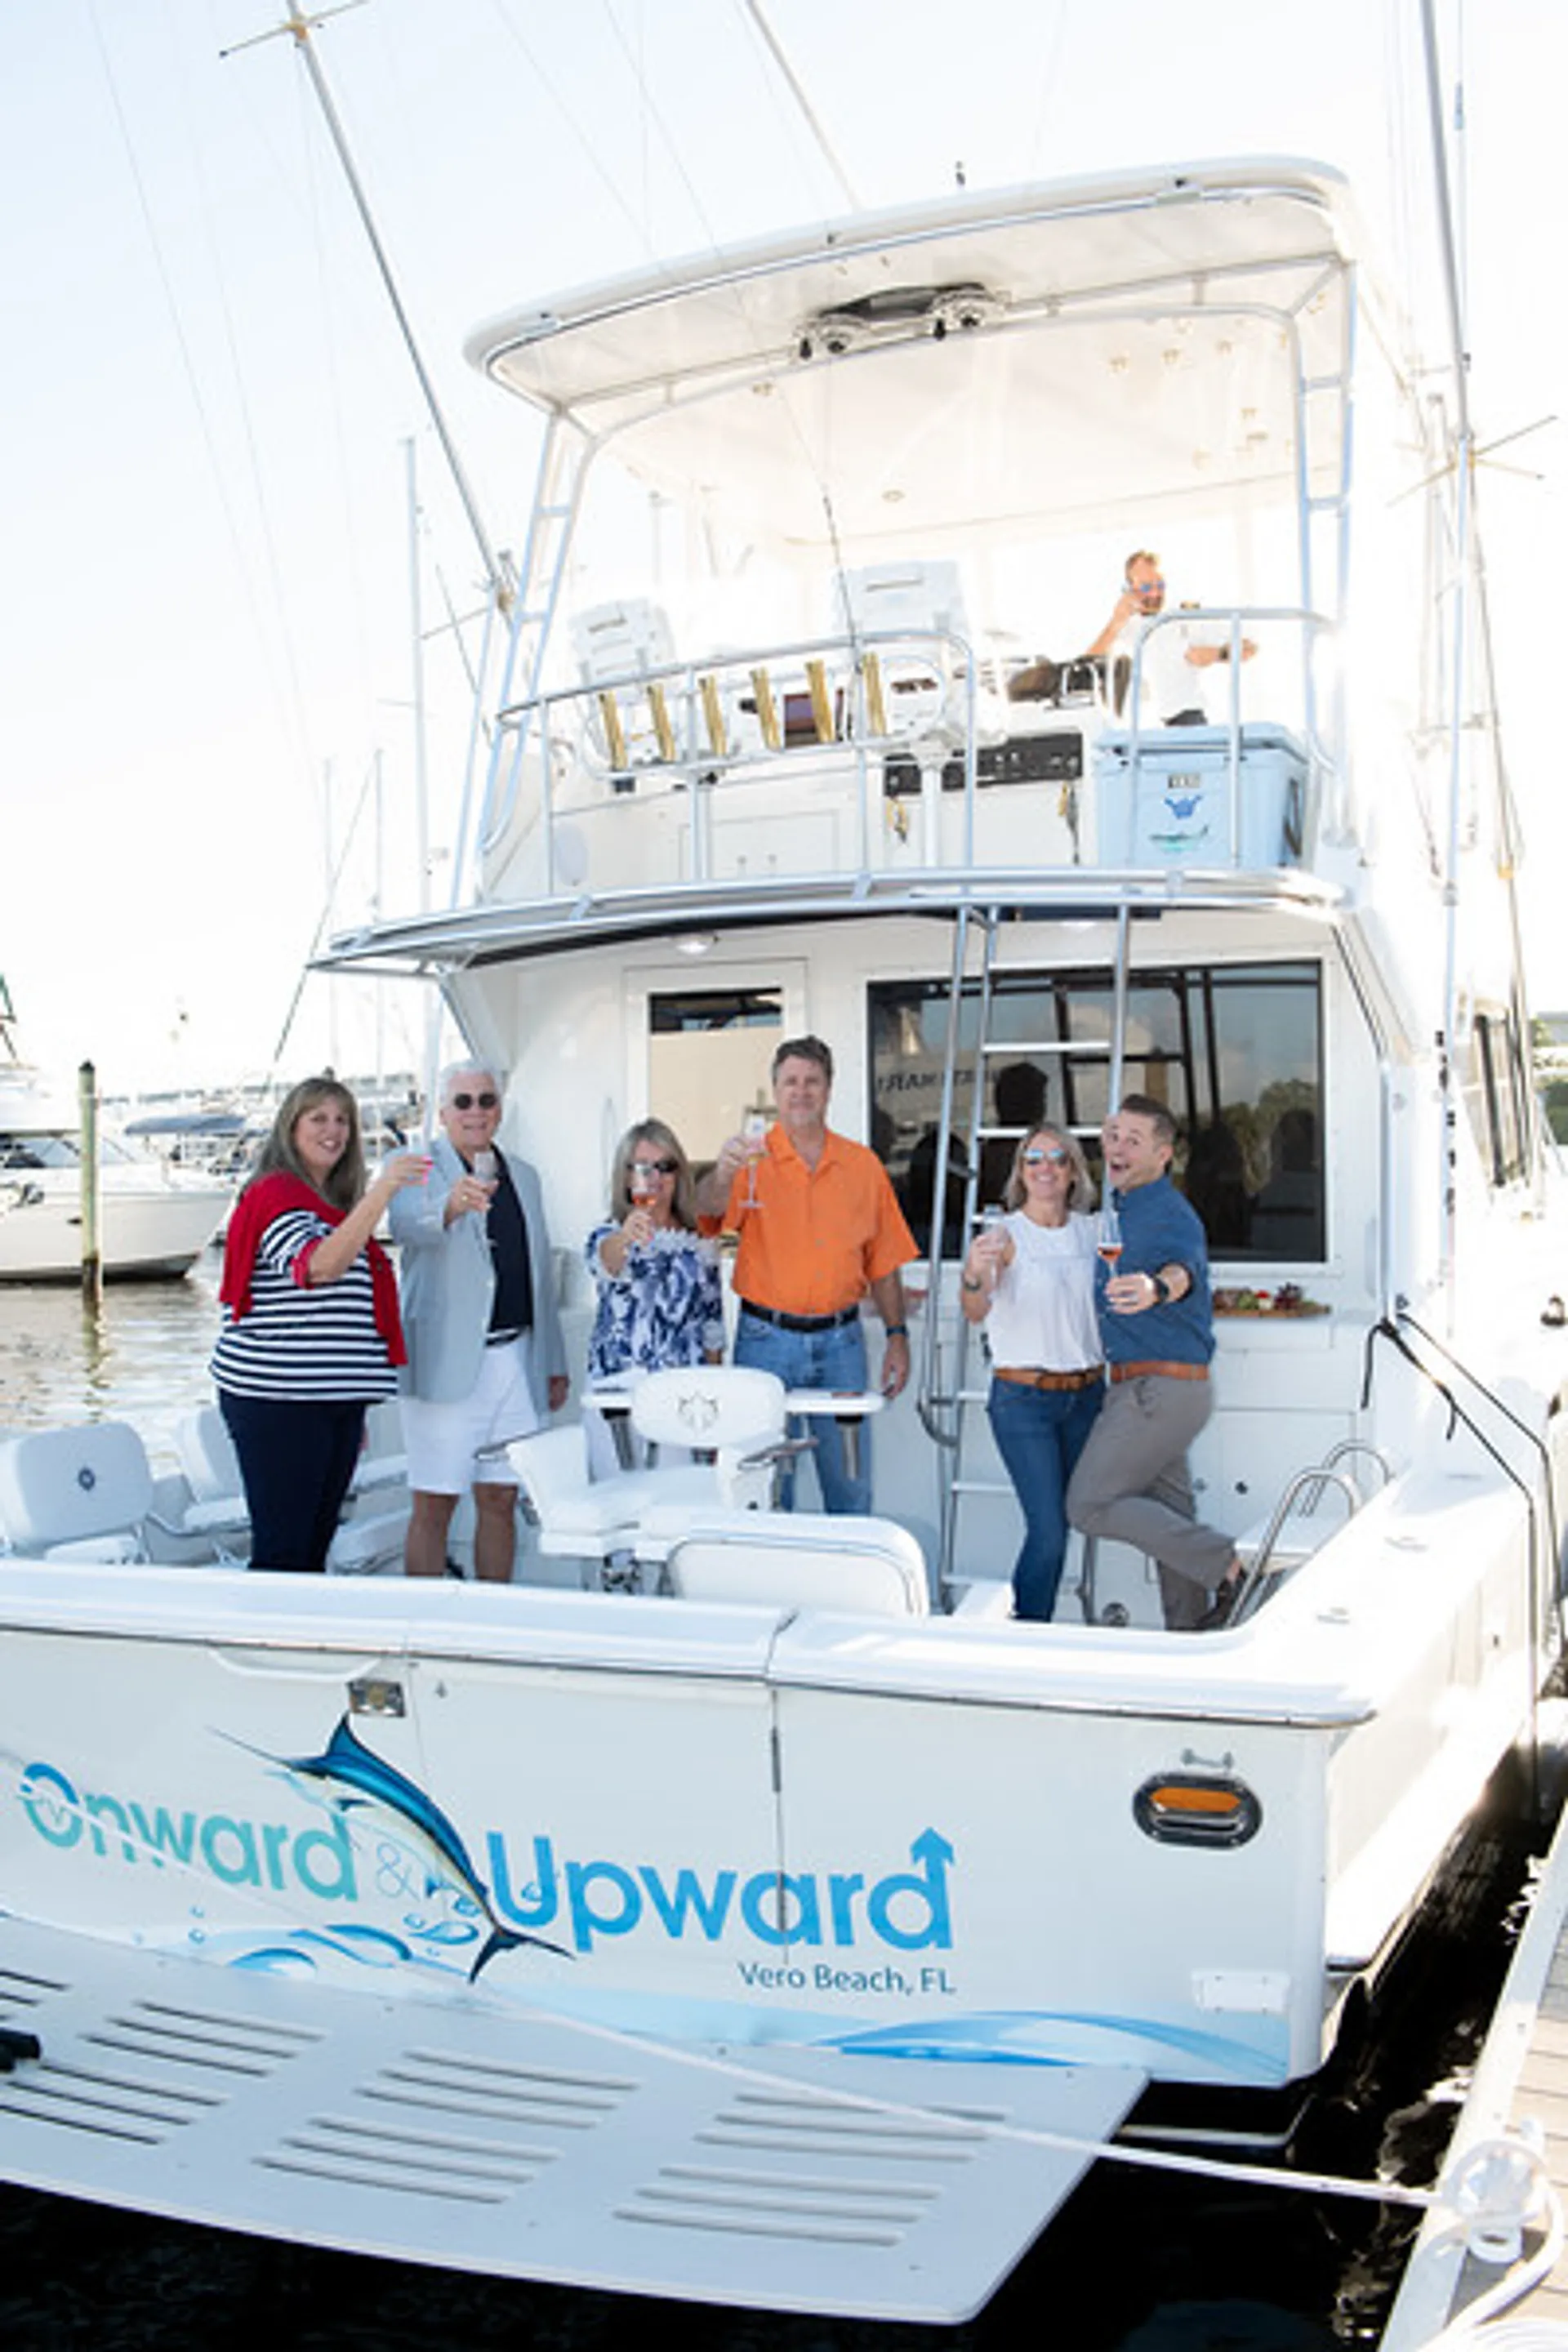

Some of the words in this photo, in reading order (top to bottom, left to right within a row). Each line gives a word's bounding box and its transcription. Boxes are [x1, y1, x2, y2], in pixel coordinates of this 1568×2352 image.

[16, 1762, 359, 1902] Onward
[486, 1827, 955, 1953] Upward
[737, 1962, 805, 1988] Vero
[815, 1963, 914, 1995] Beach,
[920, 1967, 956, 1993] FL
